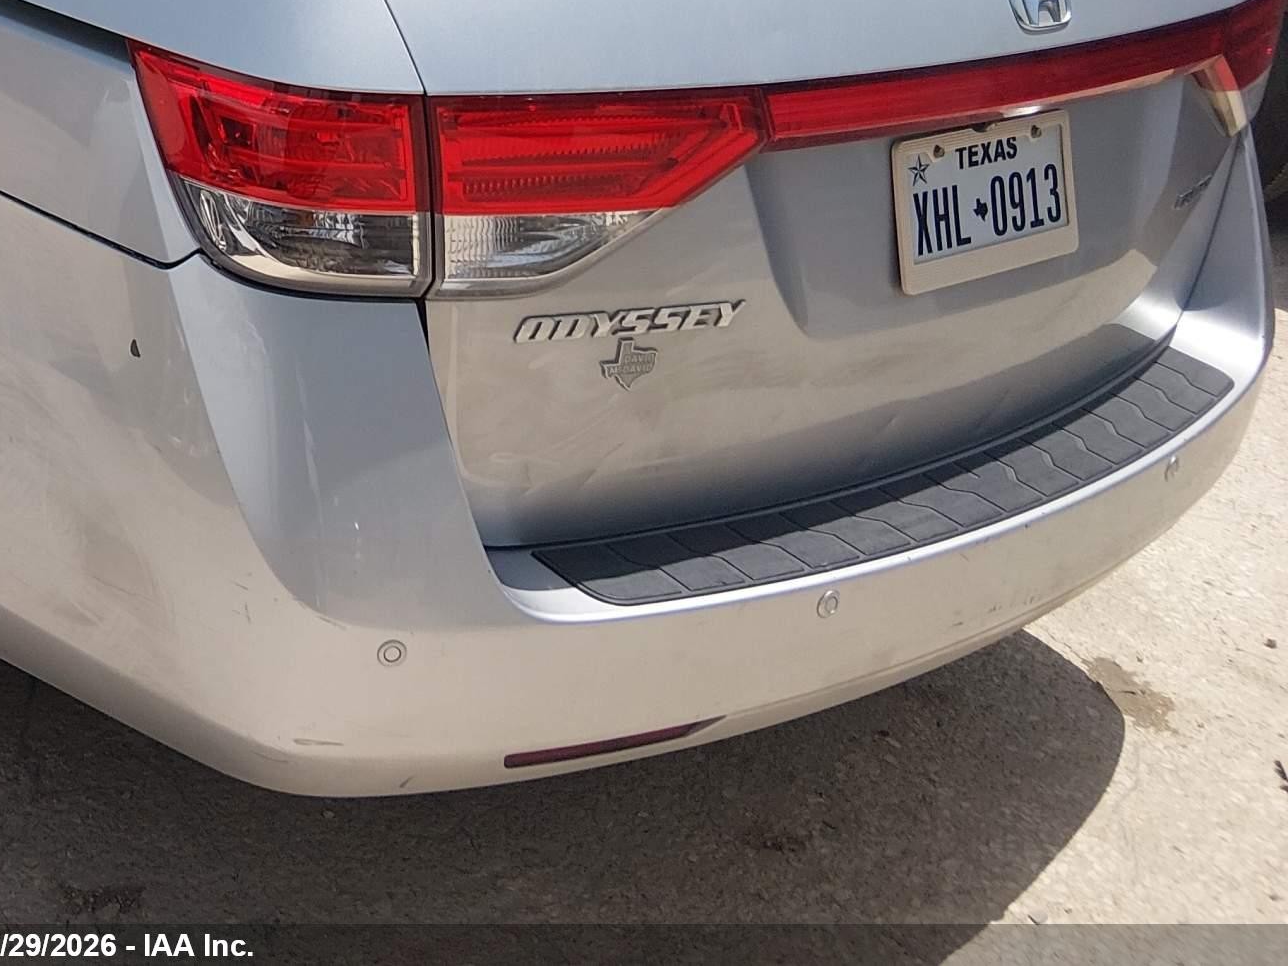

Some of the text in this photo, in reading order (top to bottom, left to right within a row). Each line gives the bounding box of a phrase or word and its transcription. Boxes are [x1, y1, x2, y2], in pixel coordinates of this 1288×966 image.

[955, 136, 1018, 170] TEXAS
[913, 163, 1062, 256] XHL 0913
[514, 298, 746, 344] ODYSSEY
